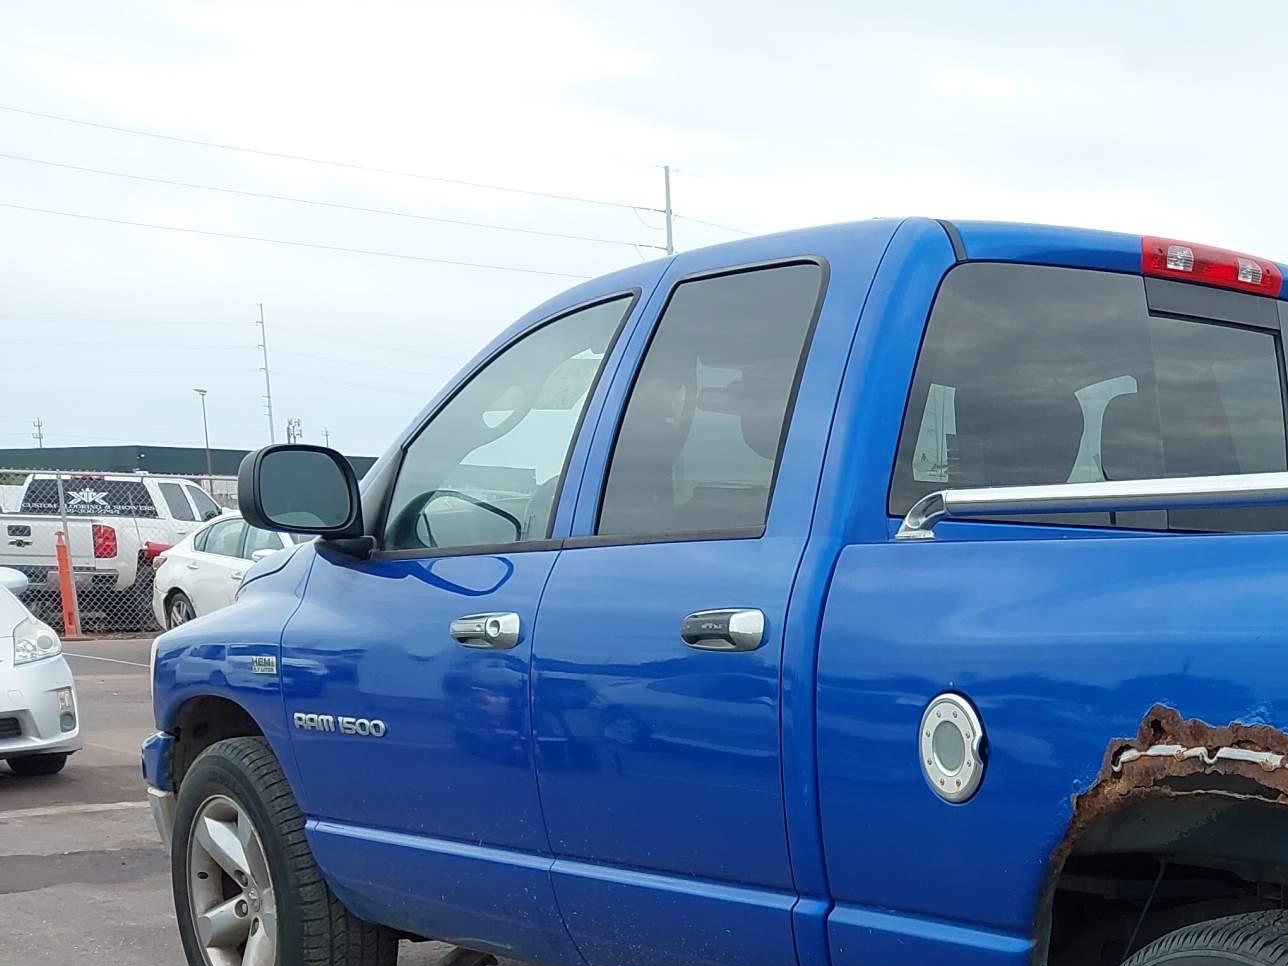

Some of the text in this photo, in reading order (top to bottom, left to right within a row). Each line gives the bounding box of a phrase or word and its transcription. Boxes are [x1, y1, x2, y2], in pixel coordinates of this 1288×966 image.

[251, 657, 274, 667] HEMI
[293, 712, 386, 737] RAM 1500
